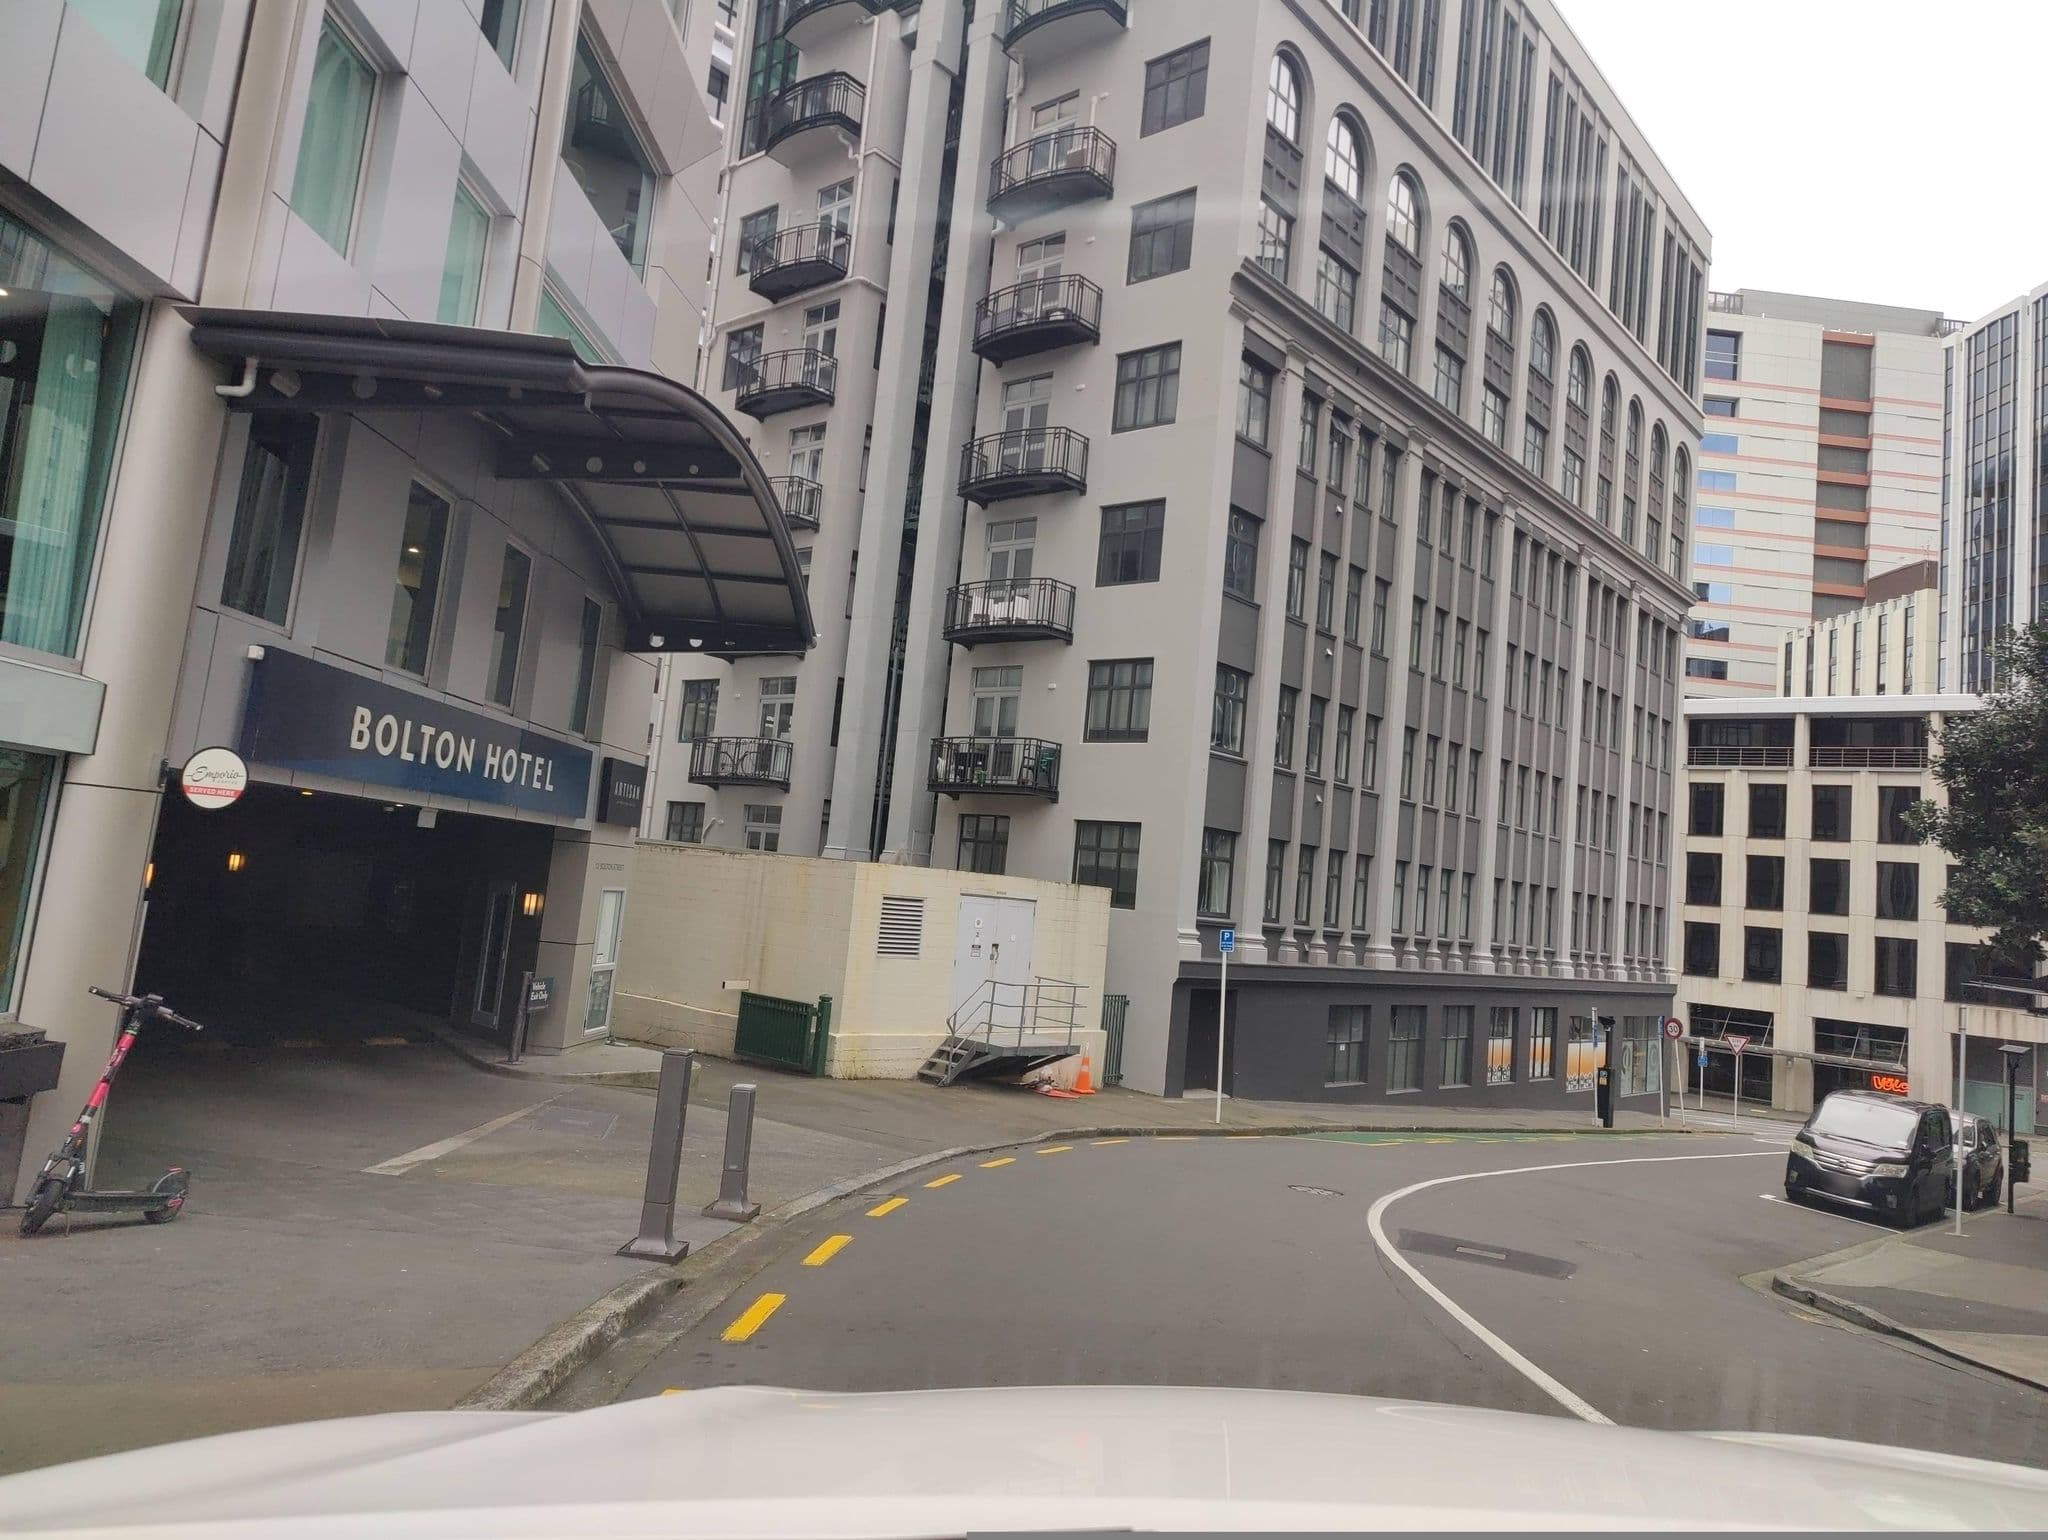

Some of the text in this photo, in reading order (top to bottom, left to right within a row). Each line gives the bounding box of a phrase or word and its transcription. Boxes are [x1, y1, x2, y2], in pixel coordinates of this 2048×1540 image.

[350, 705, 554, 792] BOLTON HOTEL
[191, 766, 240, 784] Emporio
[190, 786, 234, 797] SERVED HERE
[614, 781, 640, 800] ARTISAN
[1224, 932, 1230, 941] P
[1668, 1025, 1679, 1034] 30
